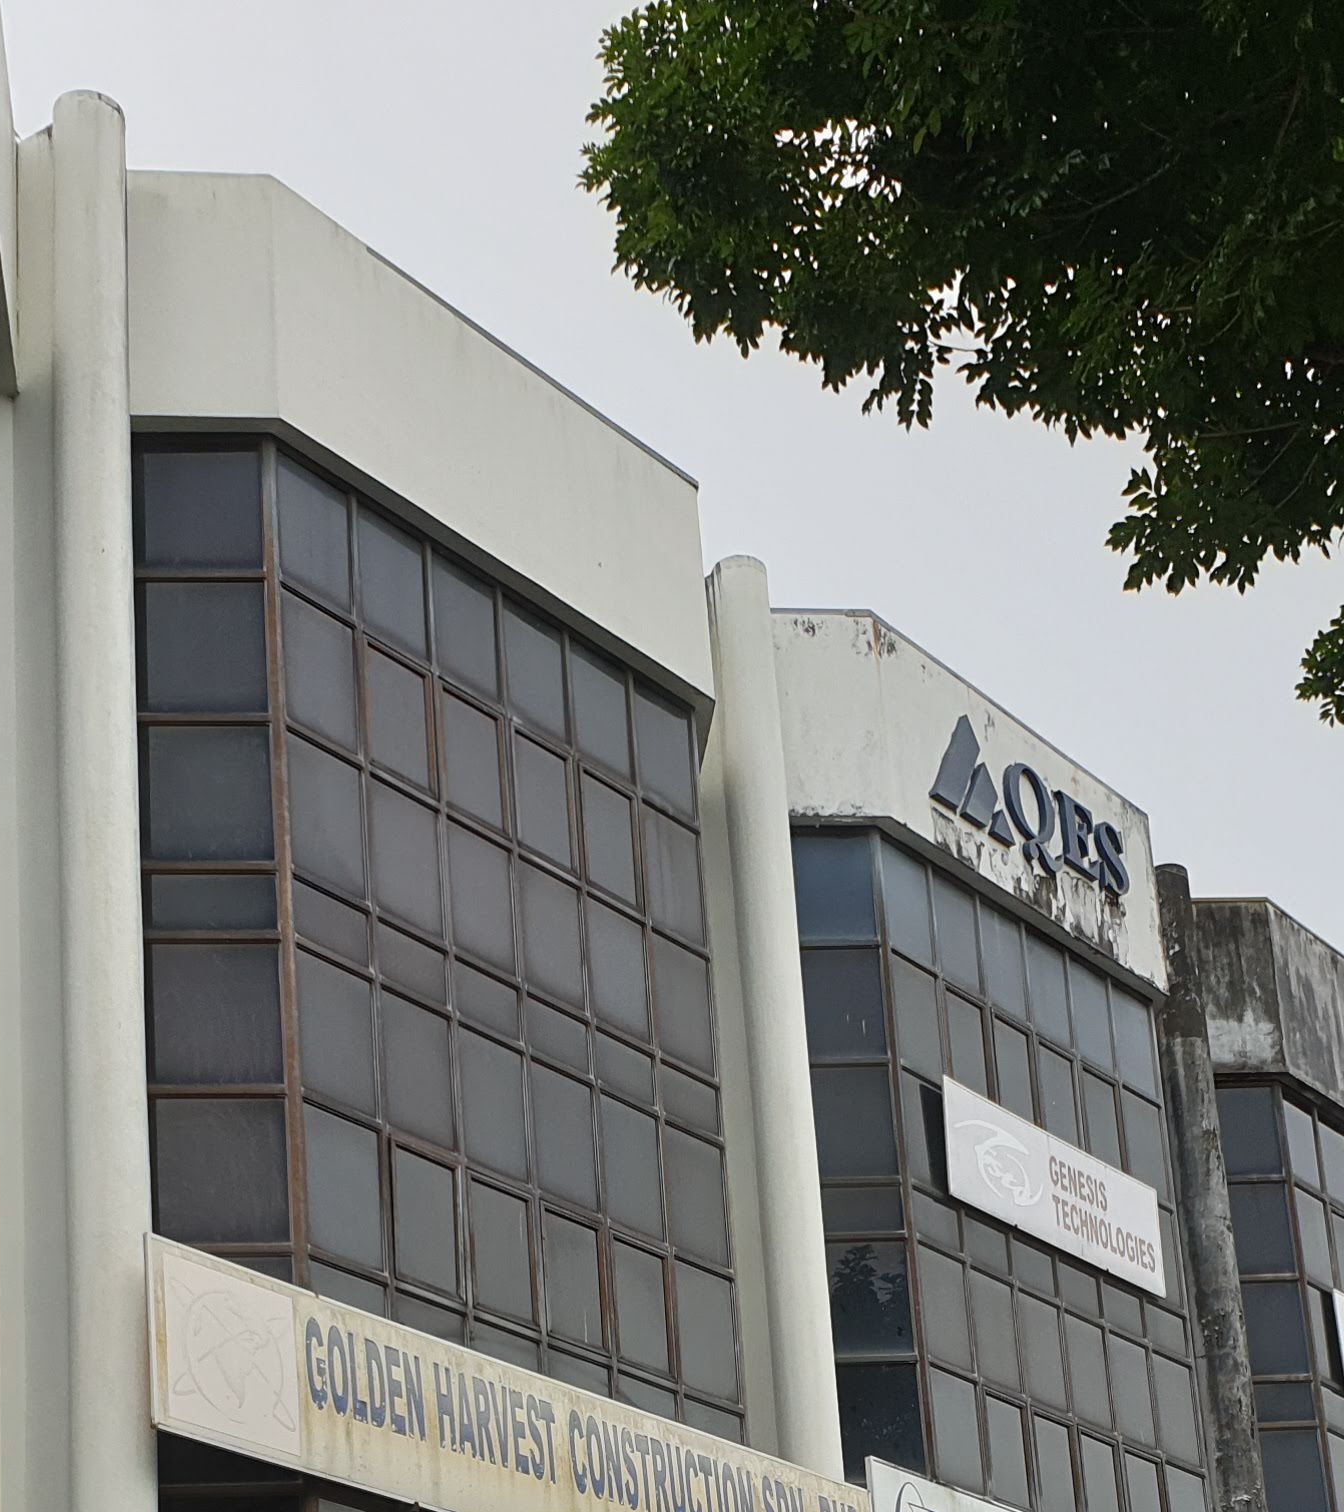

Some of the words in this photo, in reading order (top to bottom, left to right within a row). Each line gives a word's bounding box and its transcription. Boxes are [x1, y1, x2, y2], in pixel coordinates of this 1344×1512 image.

[1002, 762, 1130, 896] QES
[1048, 1154, 1109, 1212] GENESIS
[1051, 1193, 1156, 1275] TECHNOLOGIES
[304, 1316, 427, 1442] GOLDEN
[434, 1361, 557, 1485] HARVEST
